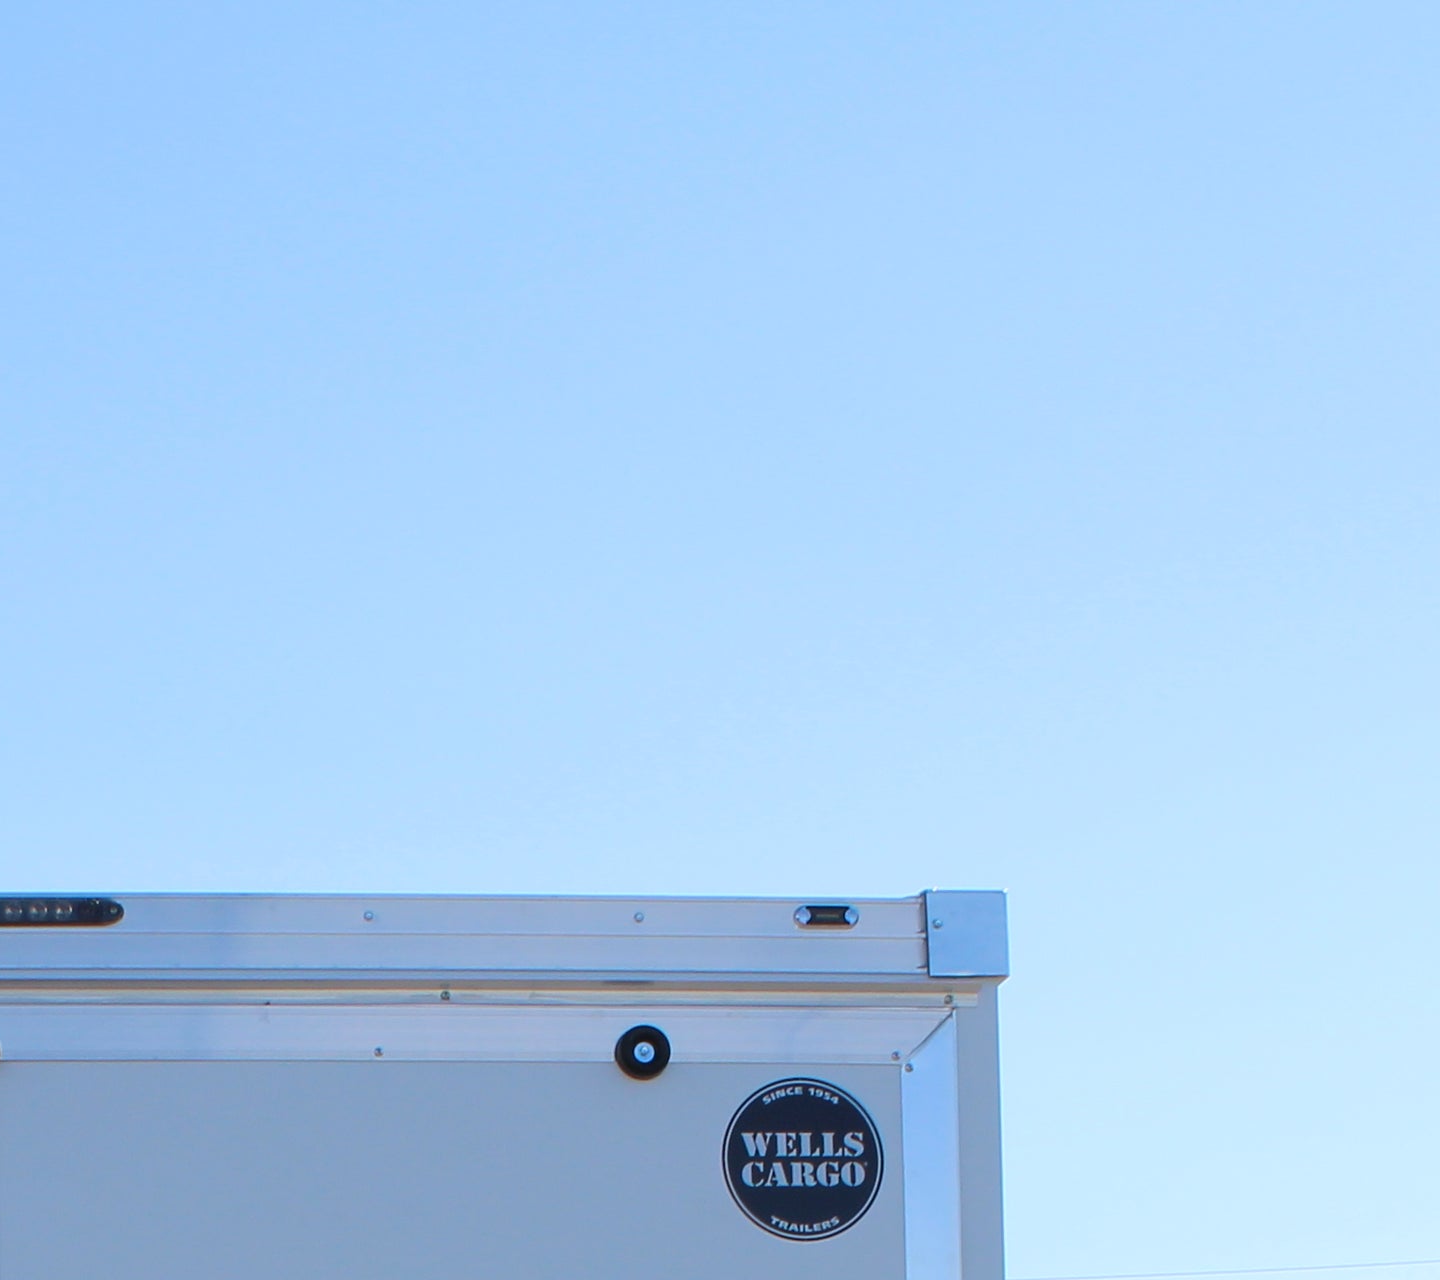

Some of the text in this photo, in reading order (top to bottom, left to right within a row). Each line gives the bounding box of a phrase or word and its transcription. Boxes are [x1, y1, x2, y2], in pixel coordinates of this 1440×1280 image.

[762, 1086, 840, 1105] SINCE 1954
[740, 1132, 865, 1157] WELLS
[741, 1161, 866, 1187] CARGO
[770, 1215, 841, 1233] TRAILERS
